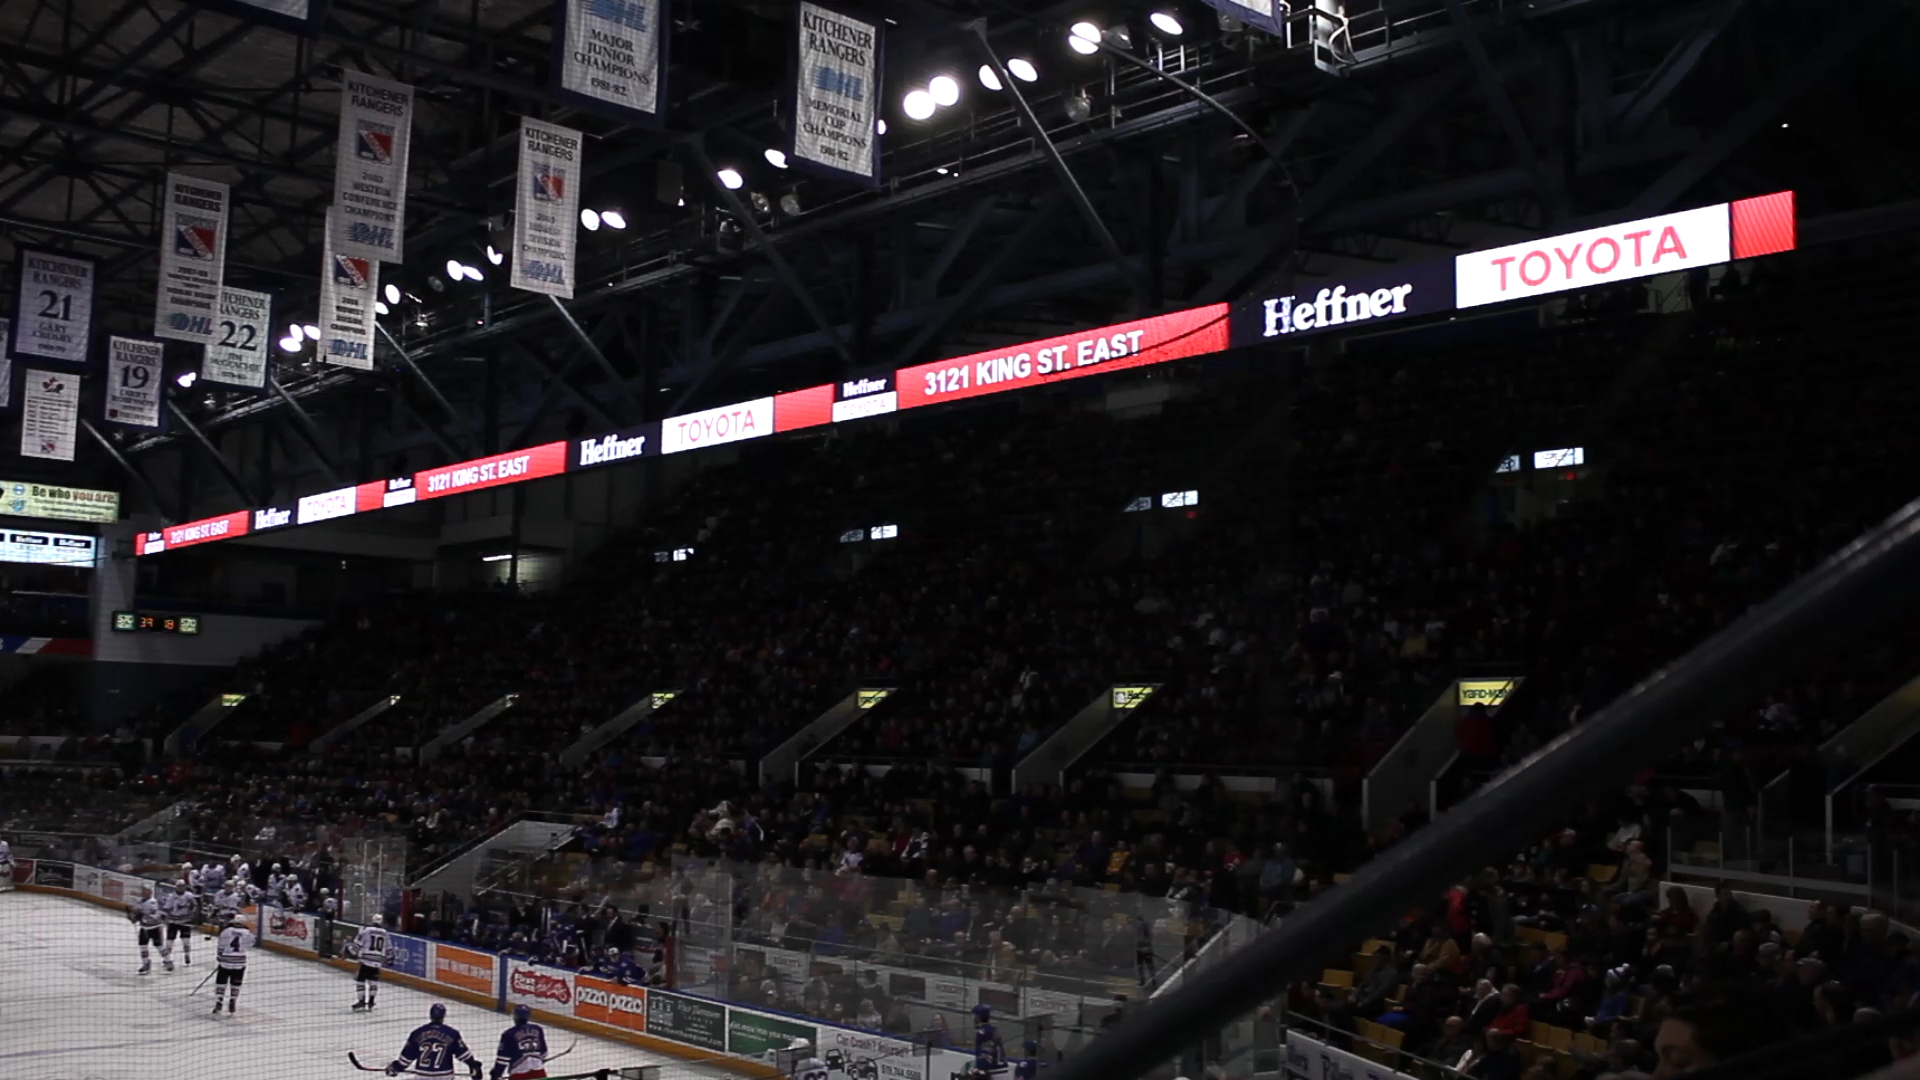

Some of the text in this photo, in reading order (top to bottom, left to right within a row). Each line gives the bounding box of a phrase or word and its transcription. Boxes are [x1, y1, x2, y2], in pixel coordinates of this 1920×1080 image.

[590, 29, 633, 52] MAJOR
[803, 12, 872, 50] KITCHENER
[587, 42, 635, 67] JUNIOR
[809, 33, 866, 67] RANGERS
[574, 52, 649, 85] CHAMPIONS
[348, 82, 409, 106] KITCHENER
[591, 77, 627, 97] 1981-82
[351, 95, 403, 117] RANGERS
[805, 99, 863, 124] MEMORIAL
[824, 114, 846, 130] CUP
[525, 127, 578, 150] KITCHENER
[803, 122, 866, 150] CHAMPIONS
[527, 140, 573, 162] RANGERS
[175, 183, 222, 201] KITCHENER
[175, 194, 221, 212] RANGERS
[28, 258, 88, 277] KITCHENER
[1490, 226, 1687, 292] TOYOTA
[33, 271, 81, 289] RANGERS
[37, 289, 73, 321] 21
[222, 292, 266, 309] TCHENER
[1262, 280, 1414, 337] Heffner
[218, 320, 258, 351] 22
[112, 341, 161, 356] KITCHENER
[116, 351, 156, 366] RANGERS
[924, 329, 1145, 397] 3121 KING ST. EAST
[122, 365, 149, 389] 19
[842, 376, 887, 398] Heffner
[678, 409, 756, 446] TOYOTA
[579, 433, 646, 467] Heffner
[428, 455, 530, 493] 3121 KING ST. EAST
[32, 485, 47, 497] Be
[48, 488, 71, 500] who
[73, 491, 93, 502] you
[307, 495, 347, 517] TOYOTA
[254, 506, 292, 531] Heffner
[229, 936, 240, 952] 4
[369, 935, 386, 952] 10
[576, 985, 607, 1007] pizza
[609, 993, 643, 1014] pizza
[419, 1042, 448, 1069] 27
